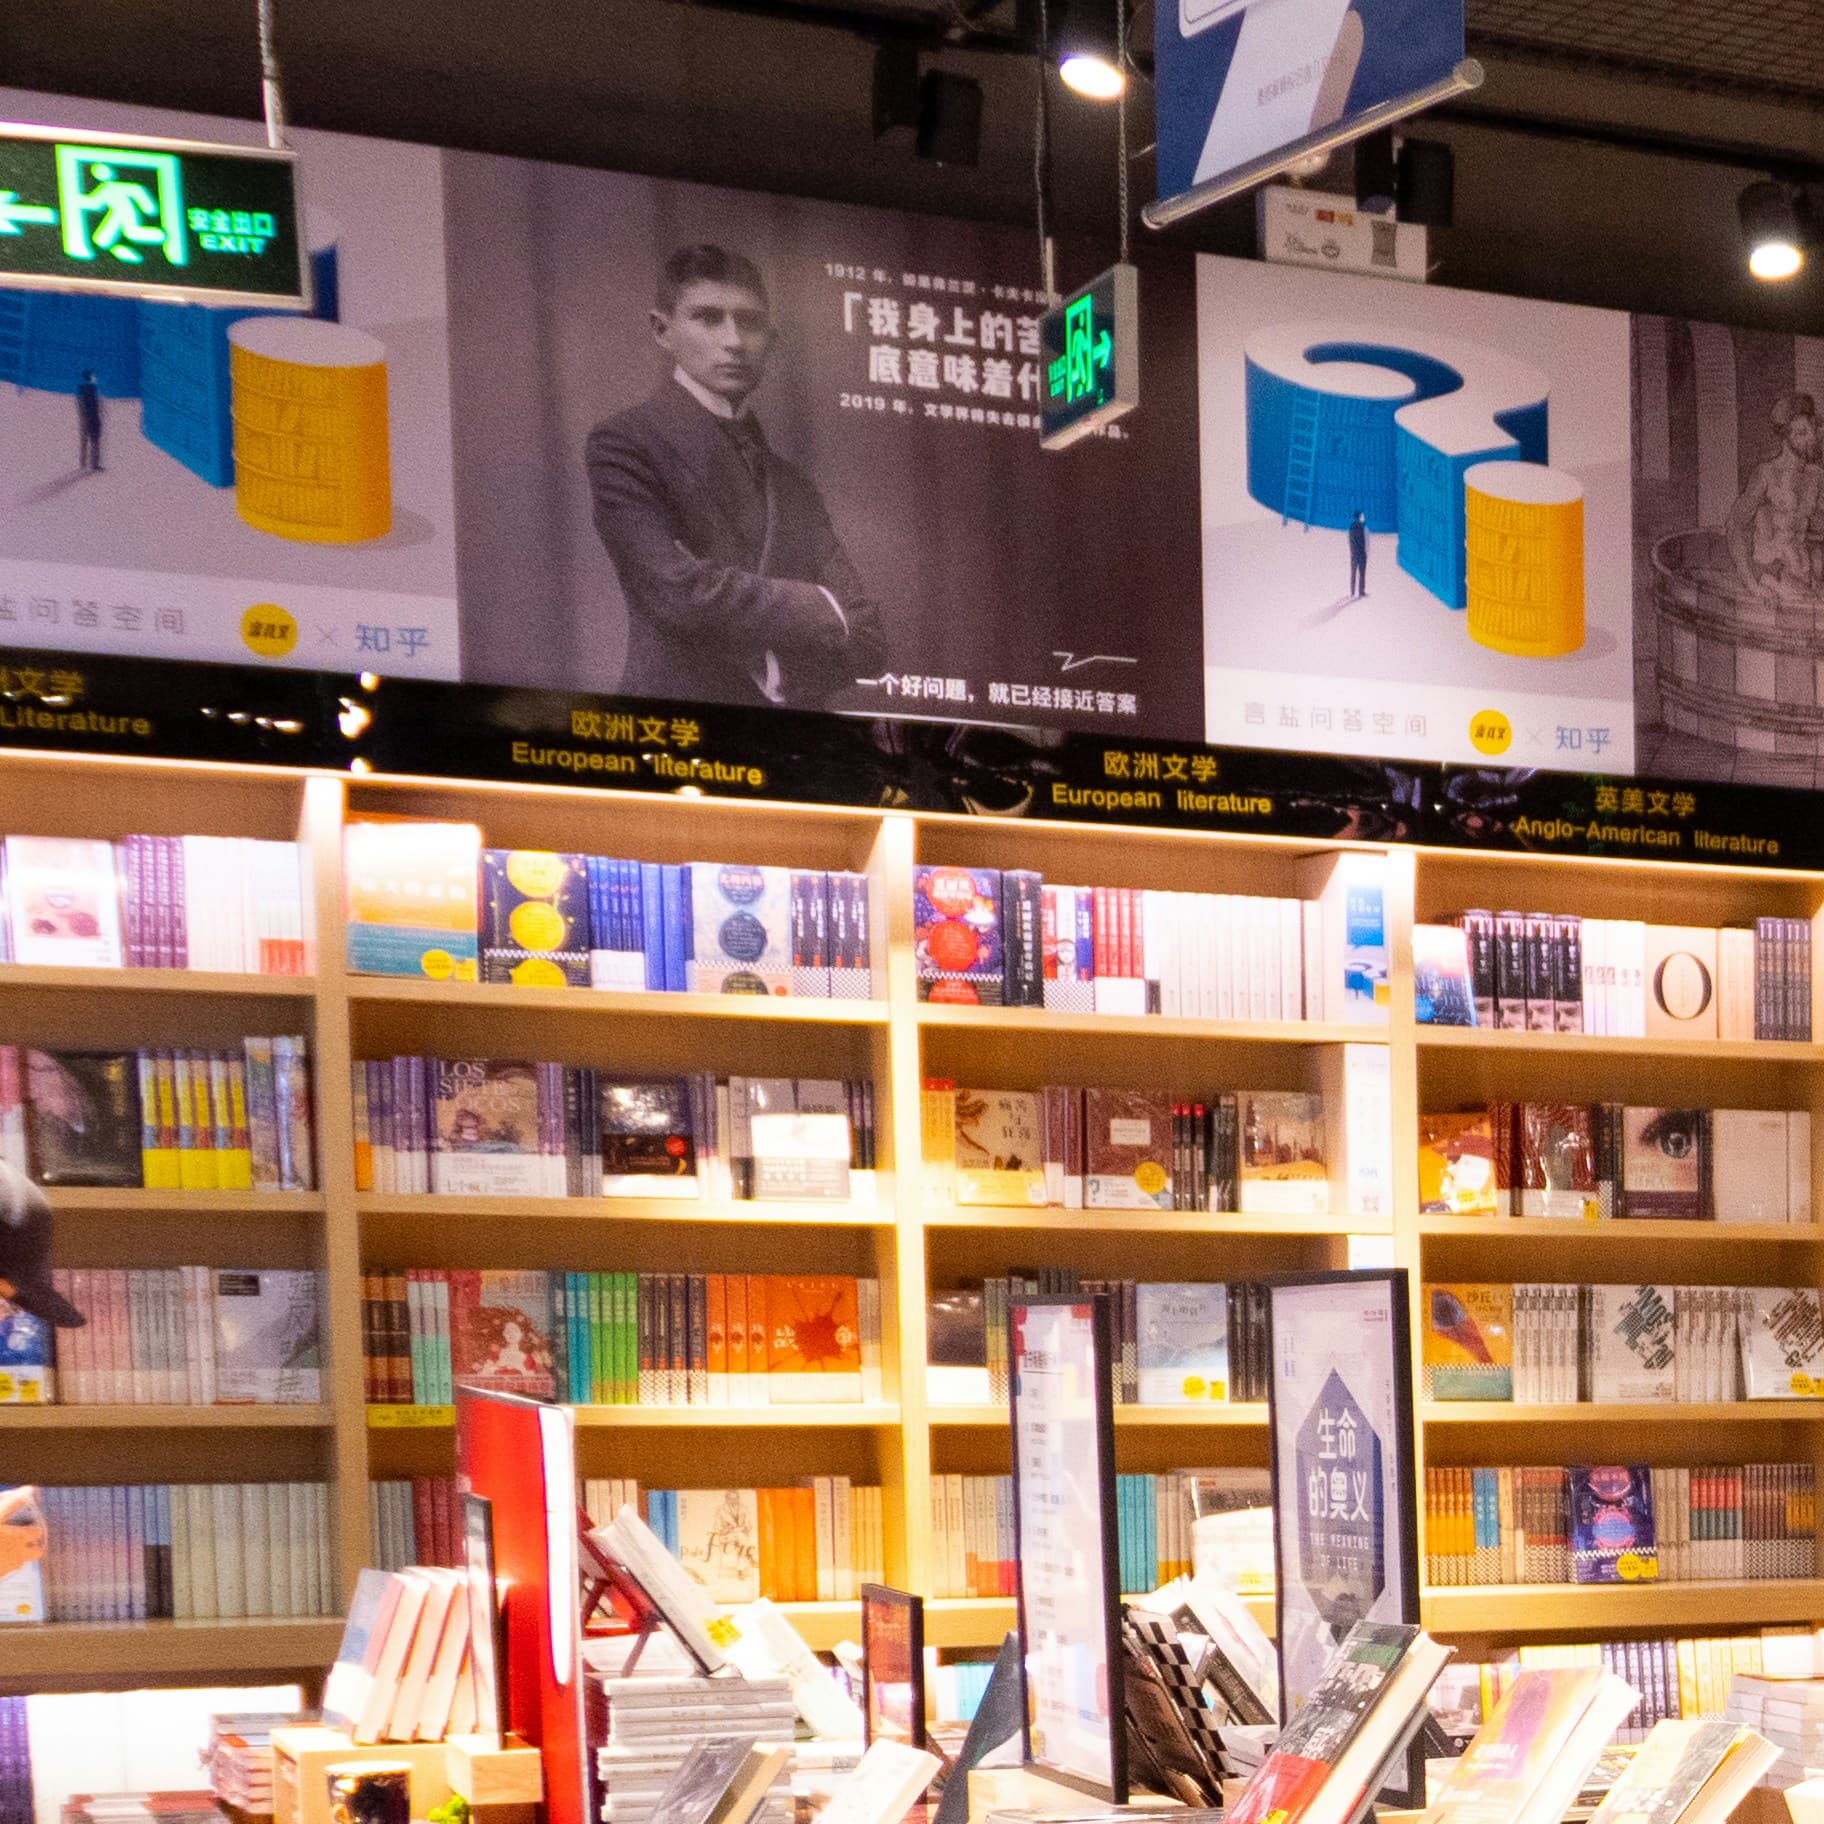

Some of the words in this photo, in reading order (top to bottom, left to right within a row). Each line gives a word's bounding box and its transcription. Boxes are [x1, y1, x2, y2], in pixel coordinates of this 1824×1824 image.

[187, 207, 276, 238] 安全出口
[199, 231, 268, 254] EXIT
[840, 393, 886, 412] 2019
[355, 621, 430, 658] 知乎
[856, 671, 1138, 717] 一个好问题，就已经接近答案
[571, 708, 701, 749] 欧洲文学
[1555, 724, 1612, 756] 知乎
[511, 740, 636, 774] European
[653, 756, 764, 787] literature
[1103, 749, 1218, 782] 欧洲文学
[1051, 783, 1162, 811] European
[1176, 790, 1273, 817] literature
[1594, 784, 1697, 818] 英美文学
[1513, 814, 1682, 851] Anglo-American
[1693, 829, 1780, 856] literature
[1317, 1407, 1358, 1460] 生命
[1308, 1470, 1371, 1522] 的奥义
